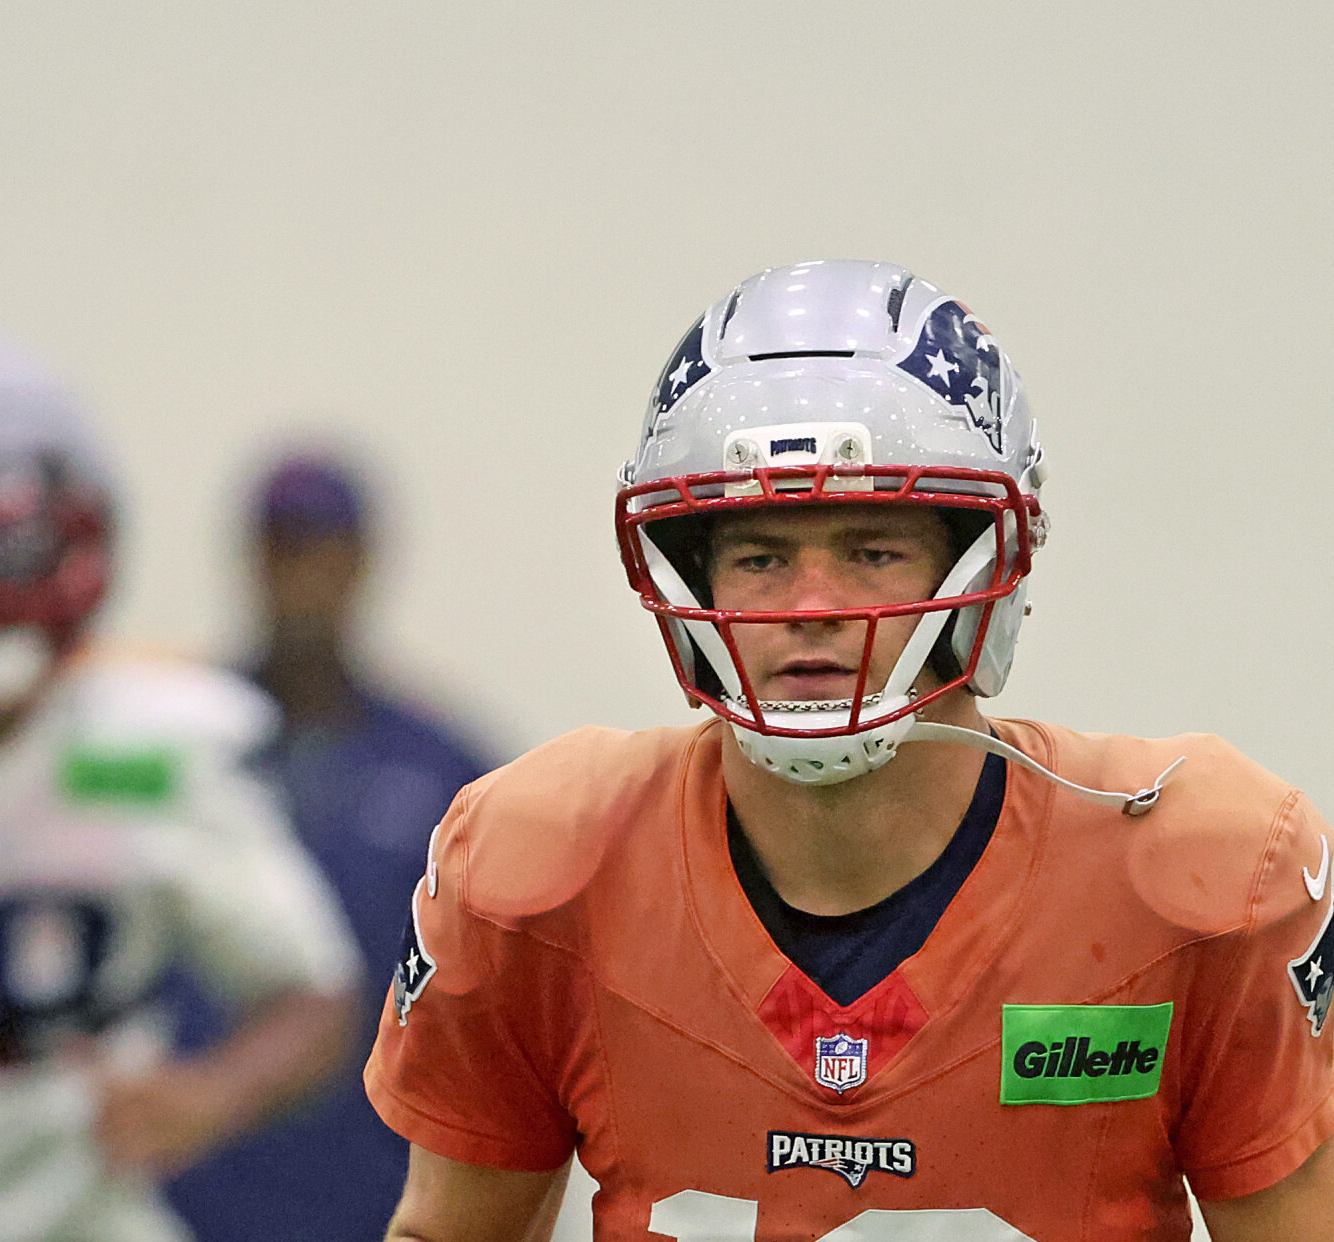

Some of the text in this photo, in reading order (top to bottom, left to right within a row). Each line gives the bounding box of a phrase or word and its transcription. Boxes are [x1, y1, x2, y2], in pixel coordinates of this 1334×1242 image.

[823, 1058, 858, 1082] NFL
[1013, 1036, 1159, 1079] Gillette
[772, 1134, 912, 1174] PATRIOTS
